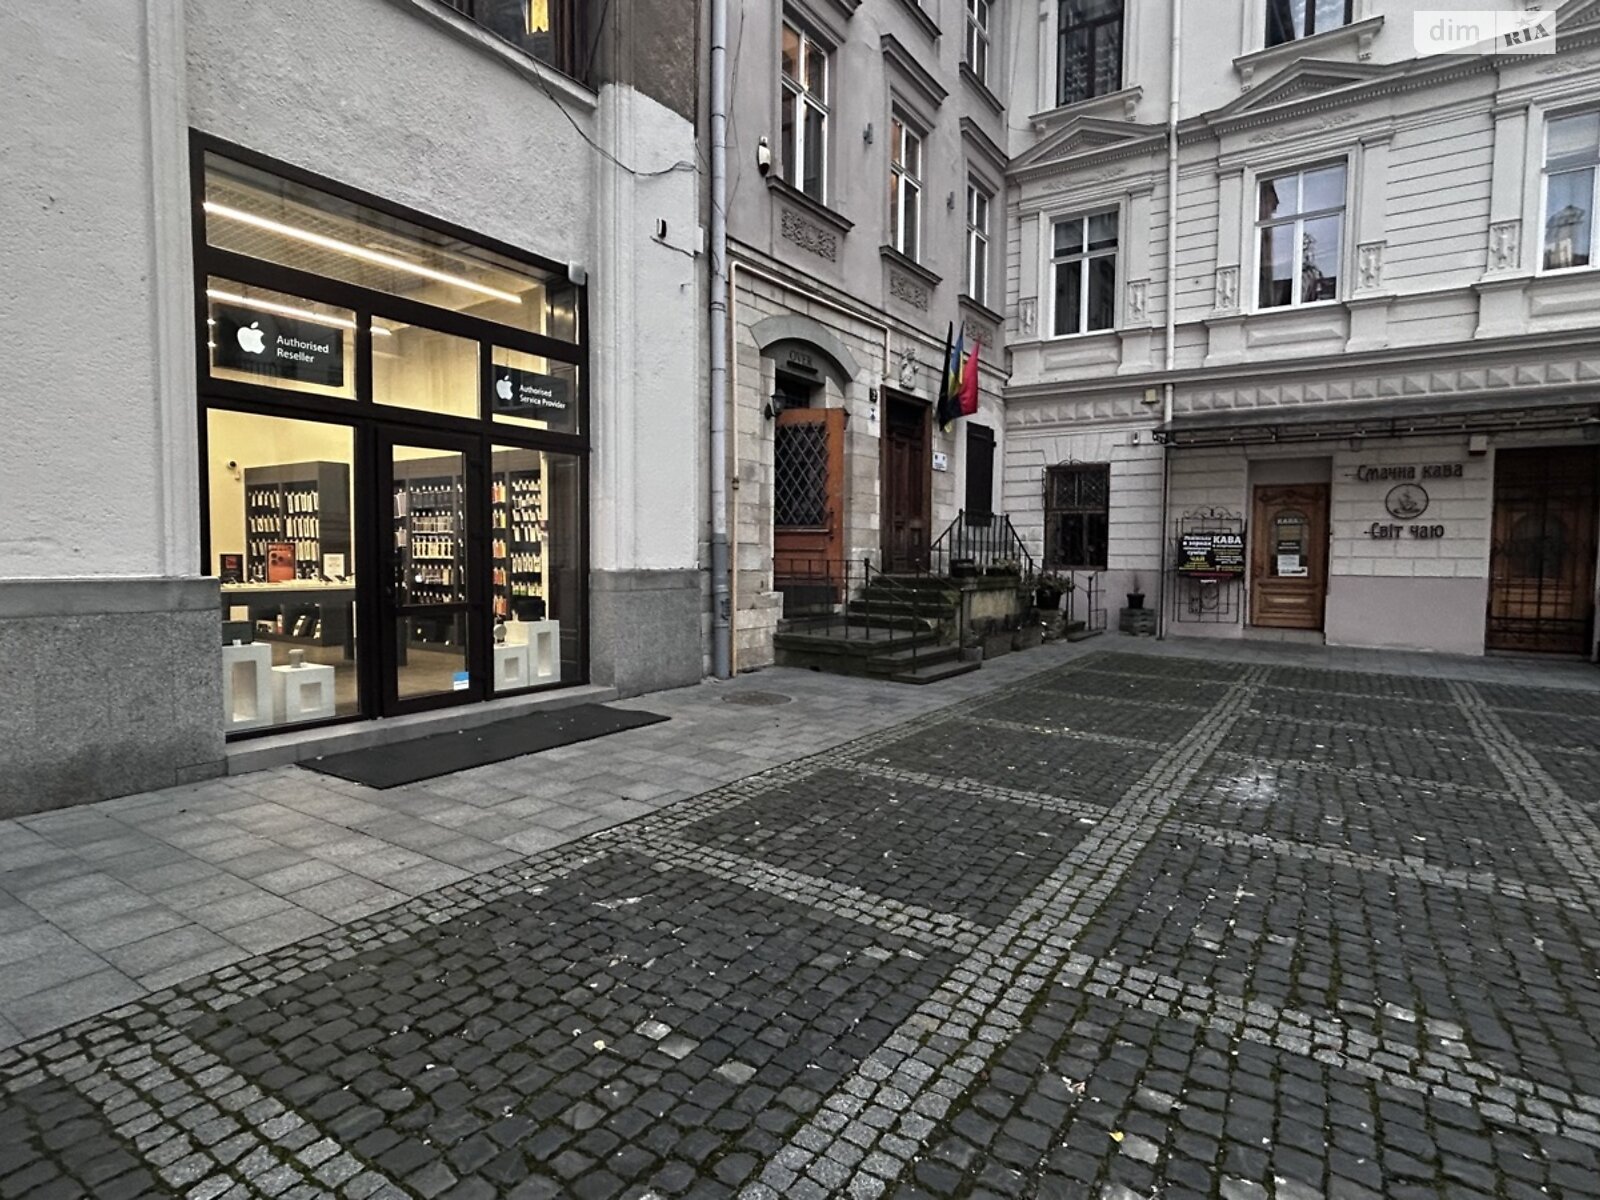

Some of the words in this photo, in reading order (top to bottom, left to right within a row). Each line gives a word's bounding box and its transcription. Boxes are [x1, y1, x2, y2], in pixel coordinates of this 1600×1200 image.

[277, 335, 330, 354] Authorised
[277, 347, 315, 363] Reseller
[519, 384, 552, 398] Authorised
[519, 394, 541, 406] Service
[542, 398, 566, 409] Provider
[1358, 464, 1415, 482] Смачна
[1370, 522, 1403, 540] Світ
[1410, 524, 1445, 539] чаю
[1213, 535, 1243, 545] КАВА
